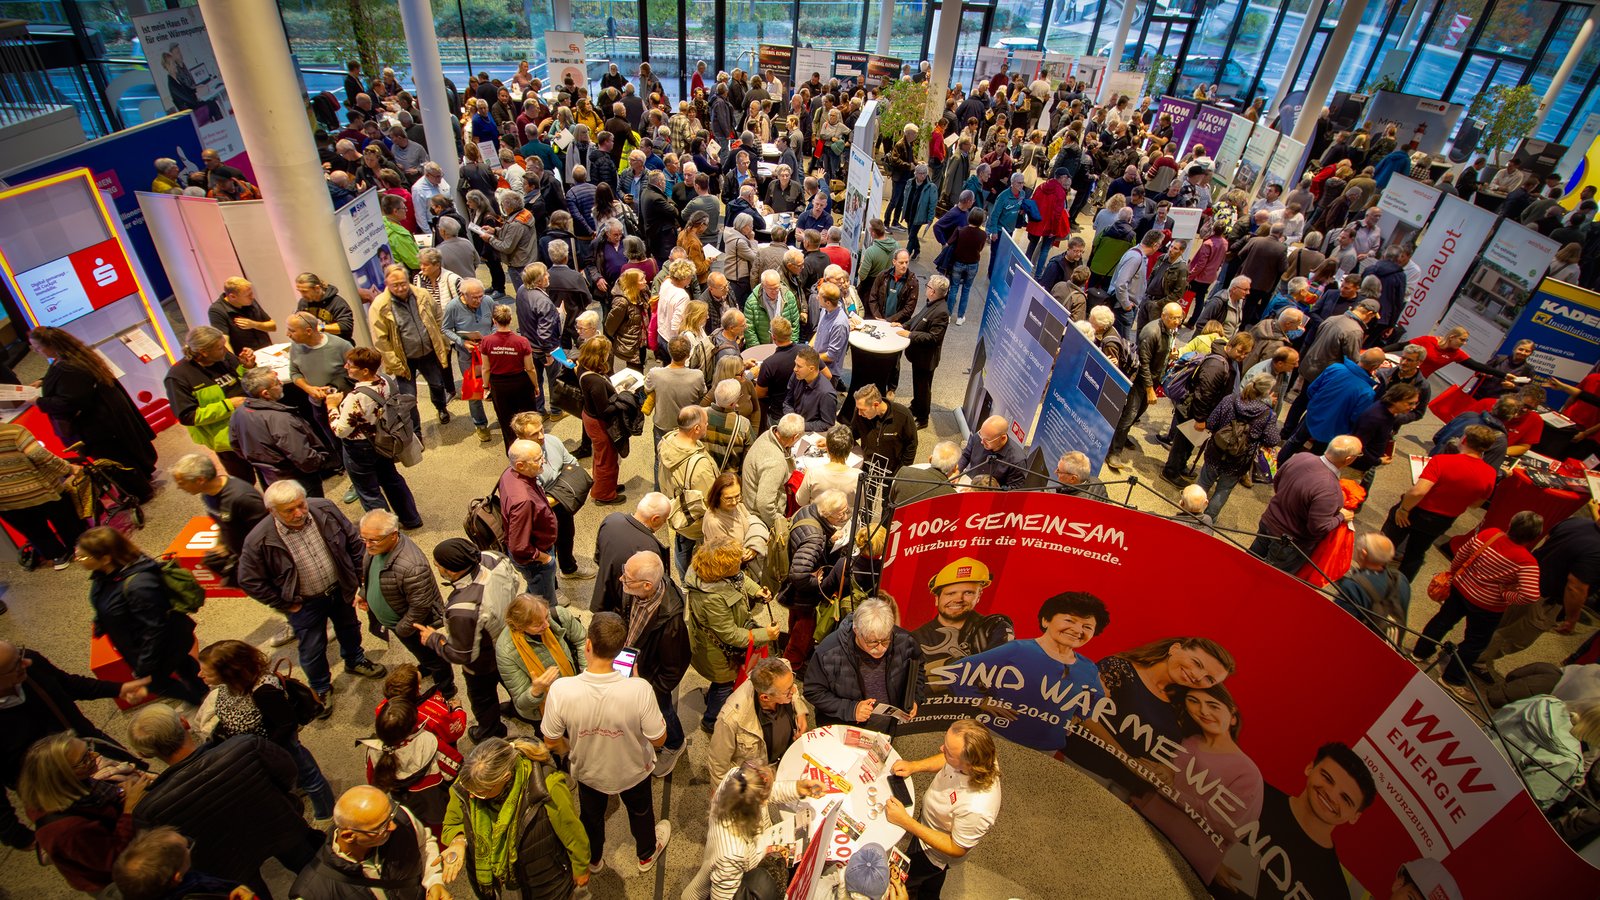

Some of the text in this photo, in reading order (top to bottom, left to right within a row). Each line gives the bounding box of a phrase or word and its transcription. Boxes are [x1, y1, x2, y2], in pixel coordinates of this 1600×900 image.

[141, 24, 151, 34] Ist
[151, 22, 166, 32] mein
[166, 20, 181, 29] Haus
[1163, 102, 1191, 118] 1KOM
[1201, 112, 1228, 127] 1KOM
[1395, 226, 1463, 330] weishaupt
[904, 536, 1122, 566] Würzburg für die Wärmewende.
[908, 512, 1128, 551] 100% GEMEINSAM.
[925, 661, 1025, 691] SIND
[1401, 699, 1496, 793] WVV
[922, 694, 1225, 854] rzburg bis 2040 klimaneutral wird.
[1386, 727, 1466, 825] ENERGIE
[1363, 754, 1379, 773] 100
[1386, 782, 1434, 852] WÜRZBURG.
